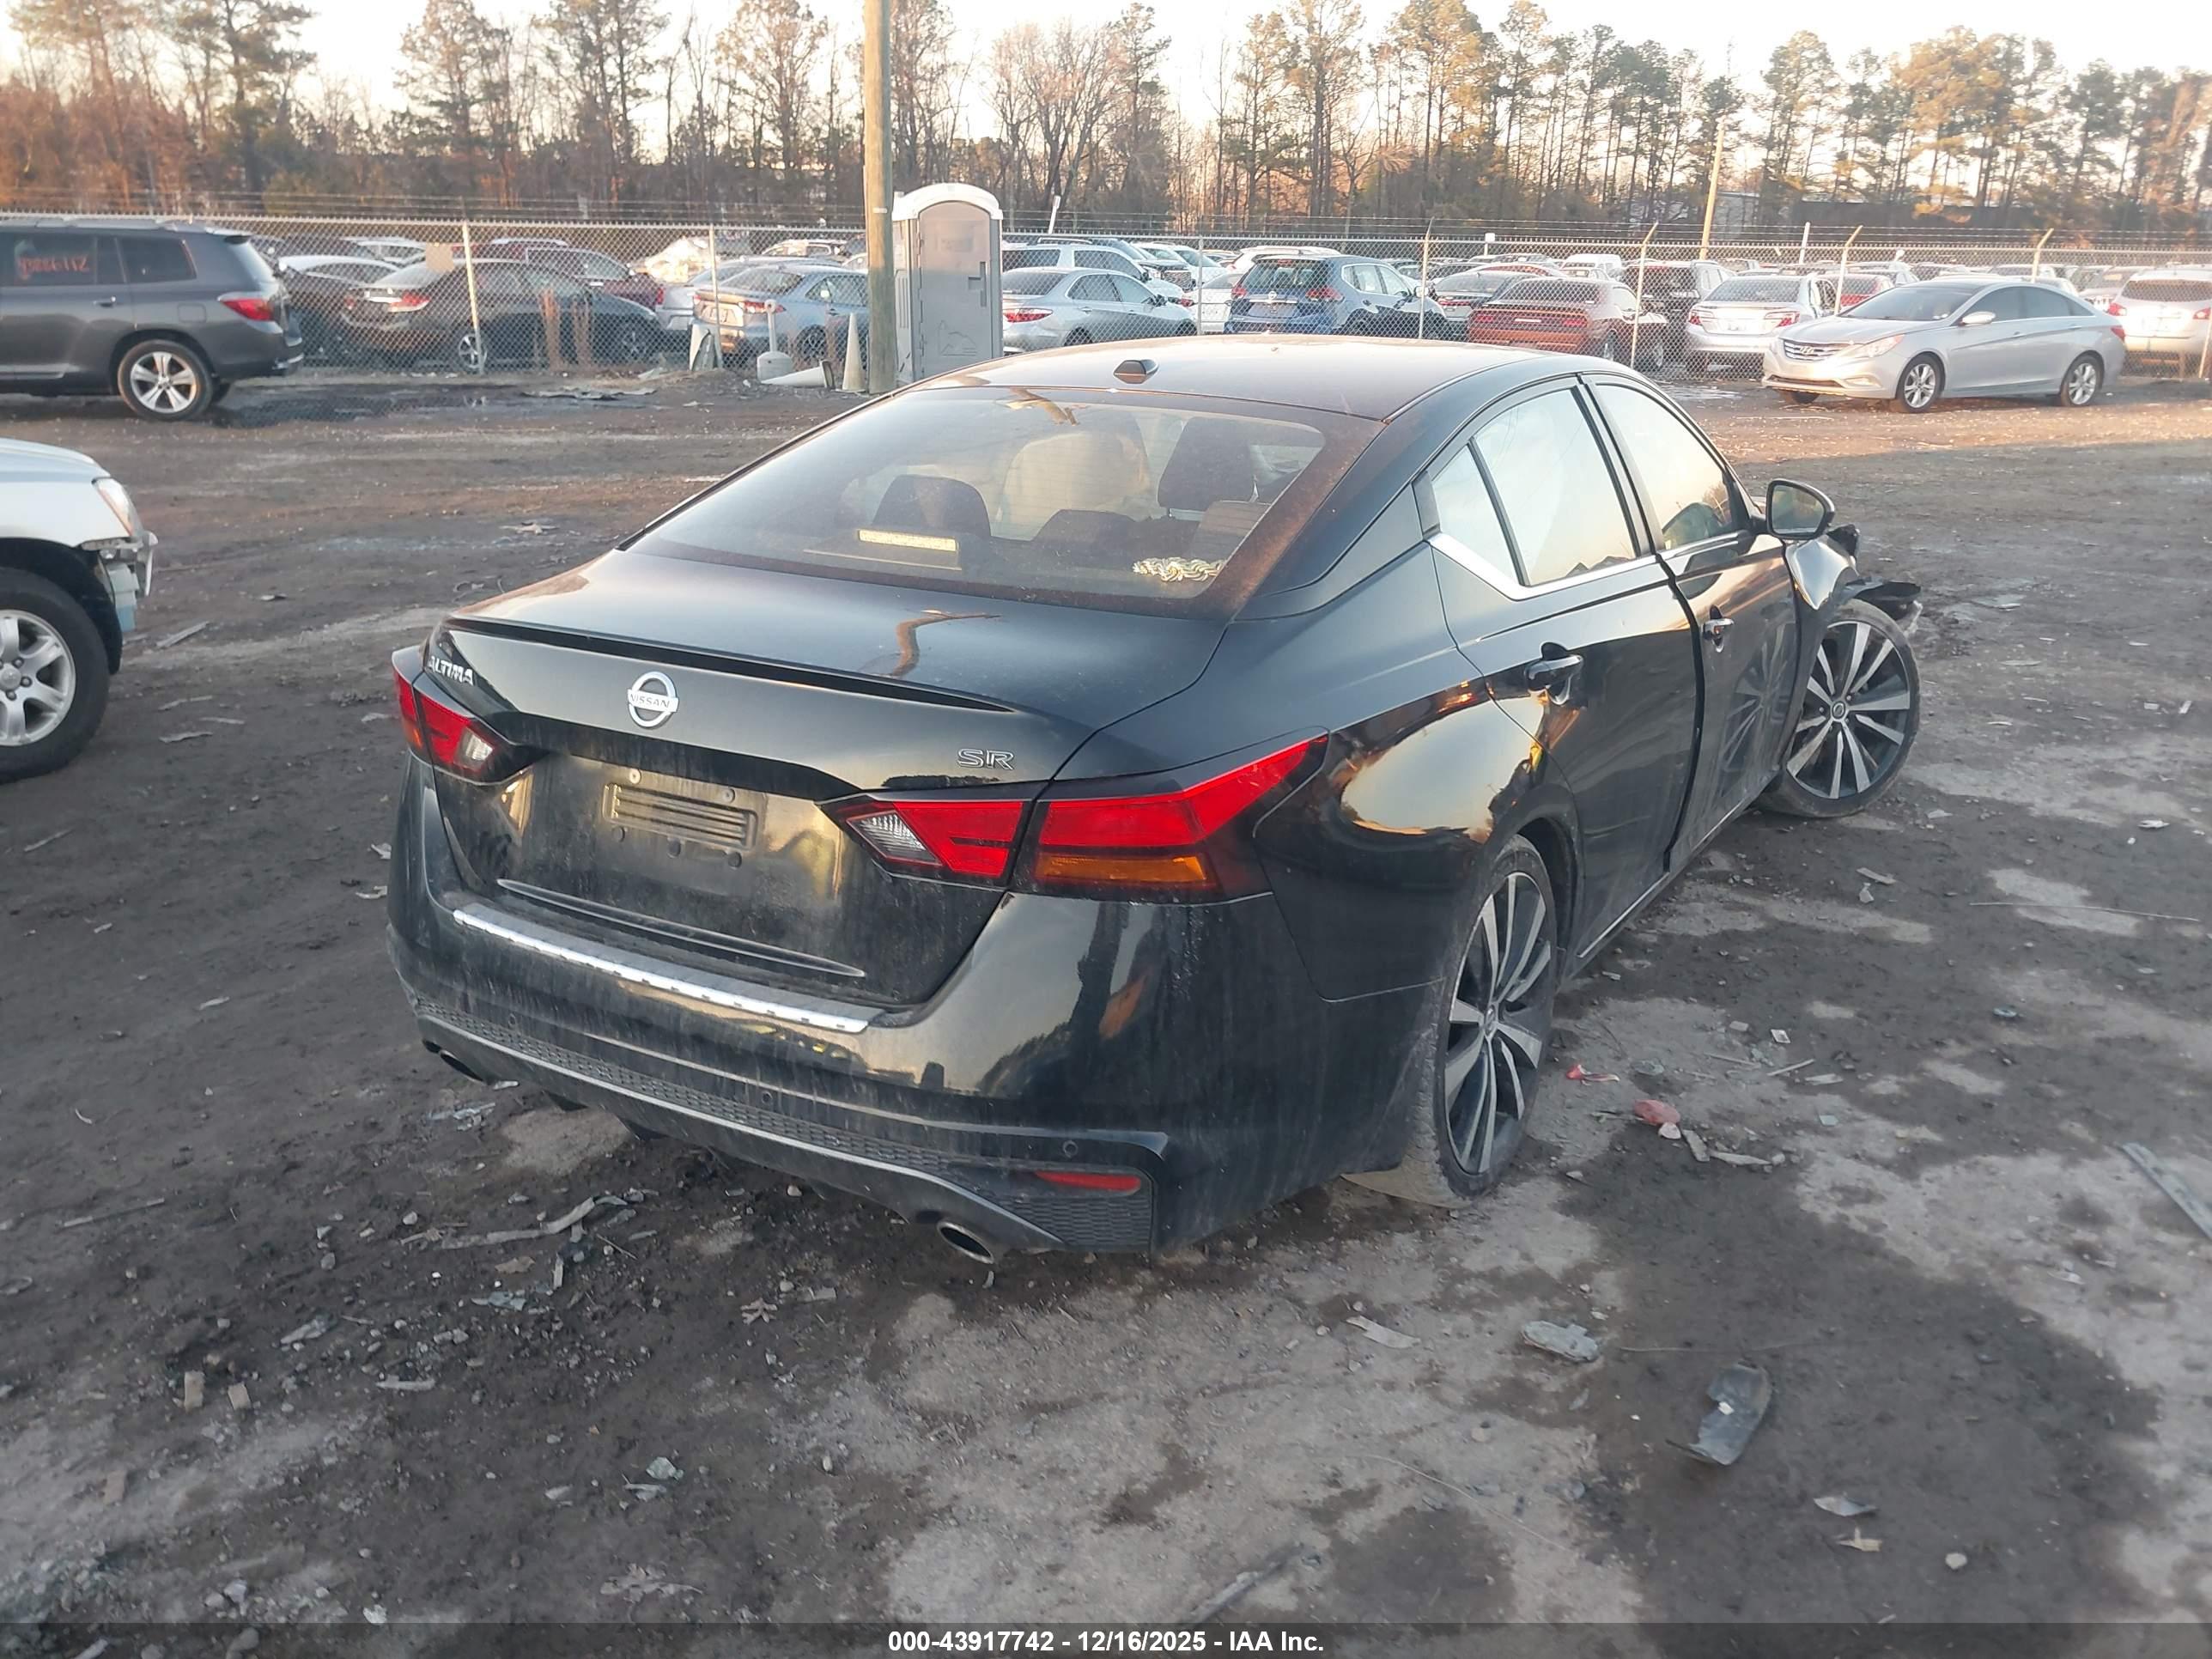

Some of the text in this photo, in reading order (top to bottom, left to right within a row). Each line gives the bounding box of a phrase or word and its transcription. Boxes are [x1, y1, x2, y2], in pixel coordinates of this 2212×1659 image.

[428, 655, 474, 686] ALTIMA
[629, 692, 671, 709] NISSAN
[957, 748, 1015, 770] SR
